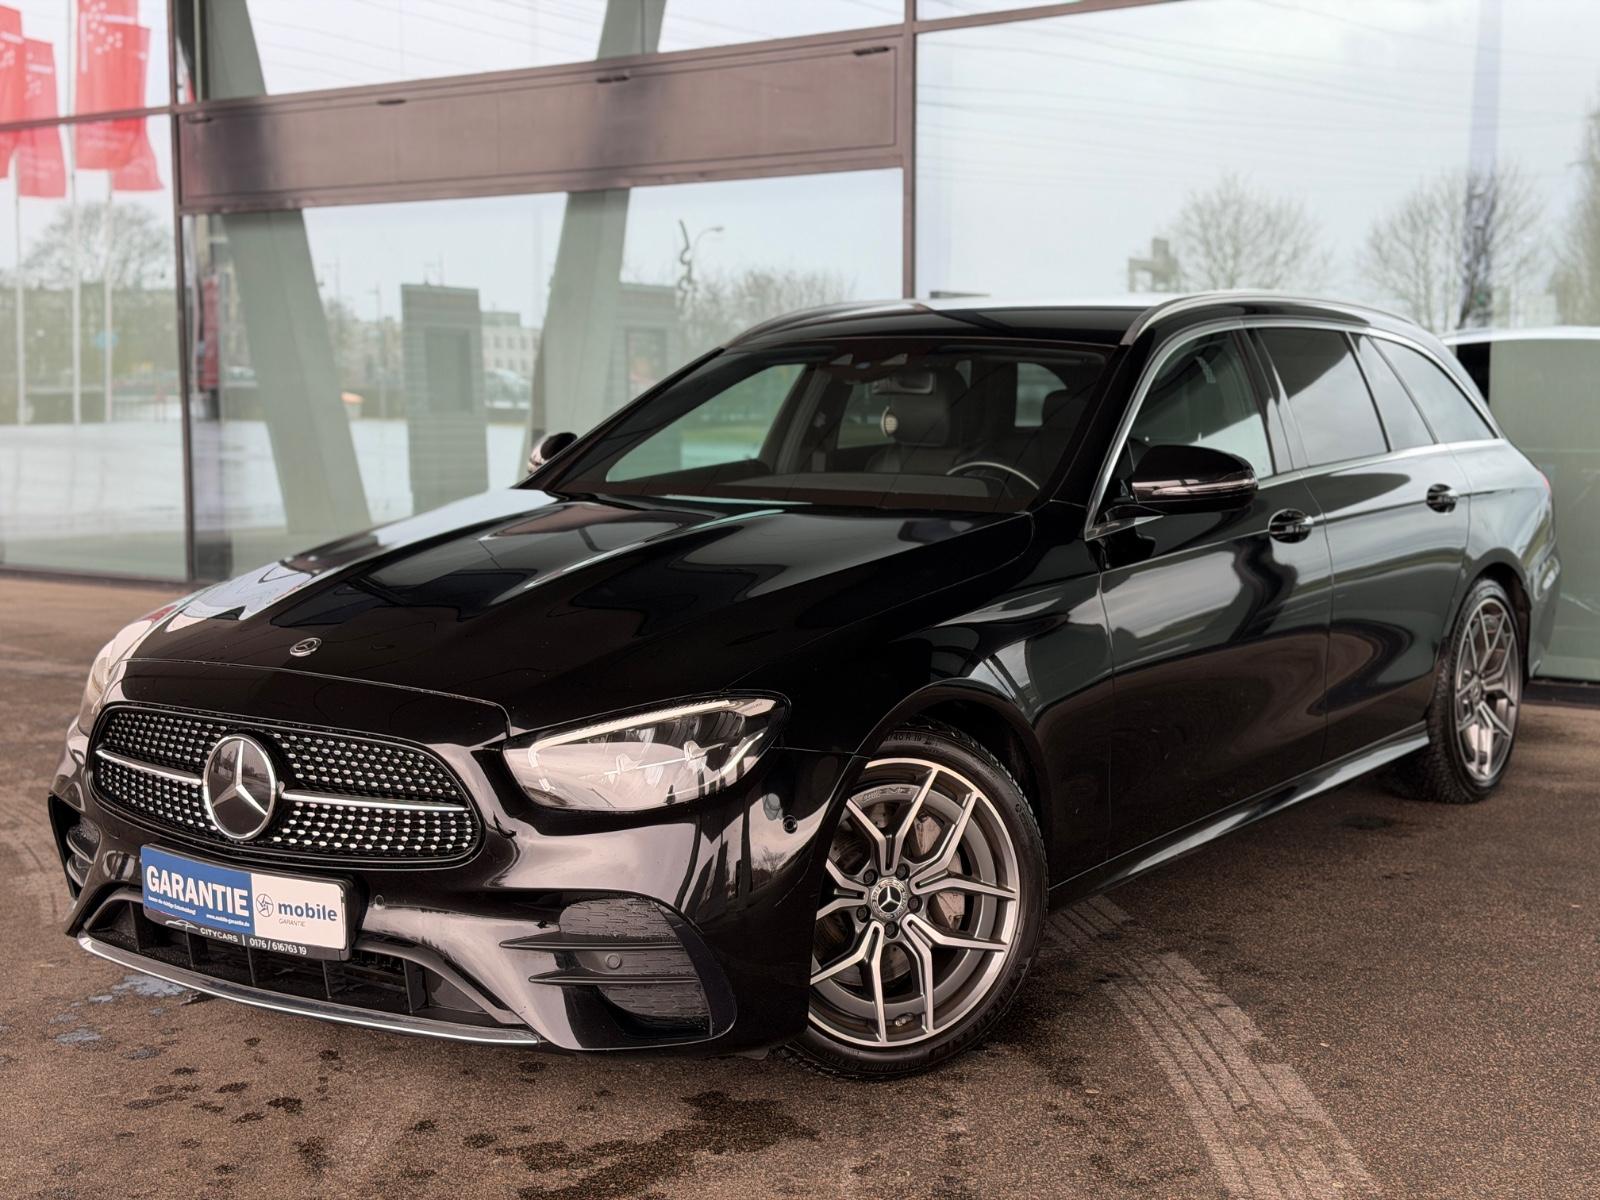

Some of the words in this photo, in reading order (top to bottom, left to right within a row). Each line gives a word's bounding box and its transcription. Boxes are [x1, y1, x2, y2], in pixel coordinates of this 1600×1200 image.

[146, 866, 250, 917] GARANTIE
[277, 902, 338, 921] mobile
[278, 918, 307, 927] GARANTIE
[200, 927, 239, 943] CITYCARS
[249, 938, 267, 949] 0176
[271, 942, 298, 954] 616763
[299, 946, 307, 955] 19
